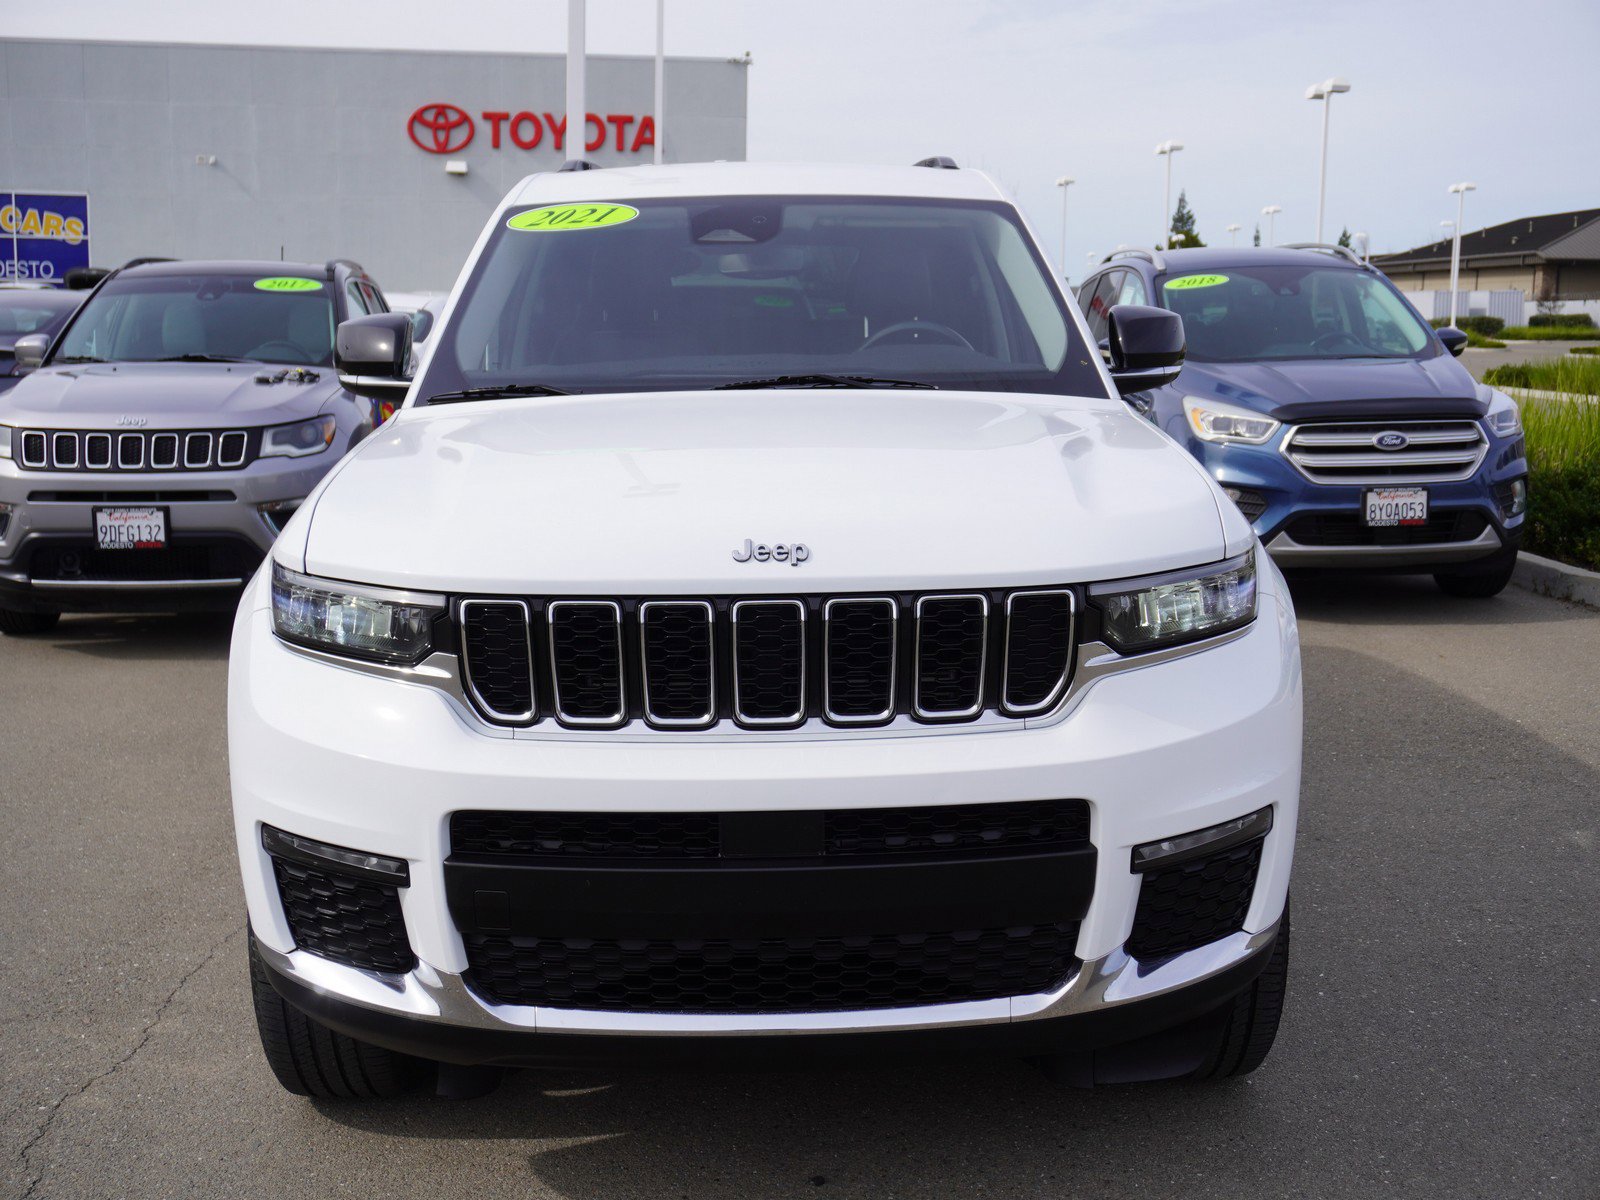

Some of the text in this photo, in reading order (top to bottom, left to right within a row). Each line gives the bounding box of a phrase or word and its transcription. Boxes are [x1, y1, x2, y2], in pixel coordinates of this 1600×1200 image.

[482, 111, 656, 152] TOYOTA
[0, 204, 84, 245] CARS
[524, 207, 619, 227] 2021
[116, 414, 147, 428] Jeep
[1382, 435, 1402, 445] Ford
[732, 538, 810, 567] Jeep
